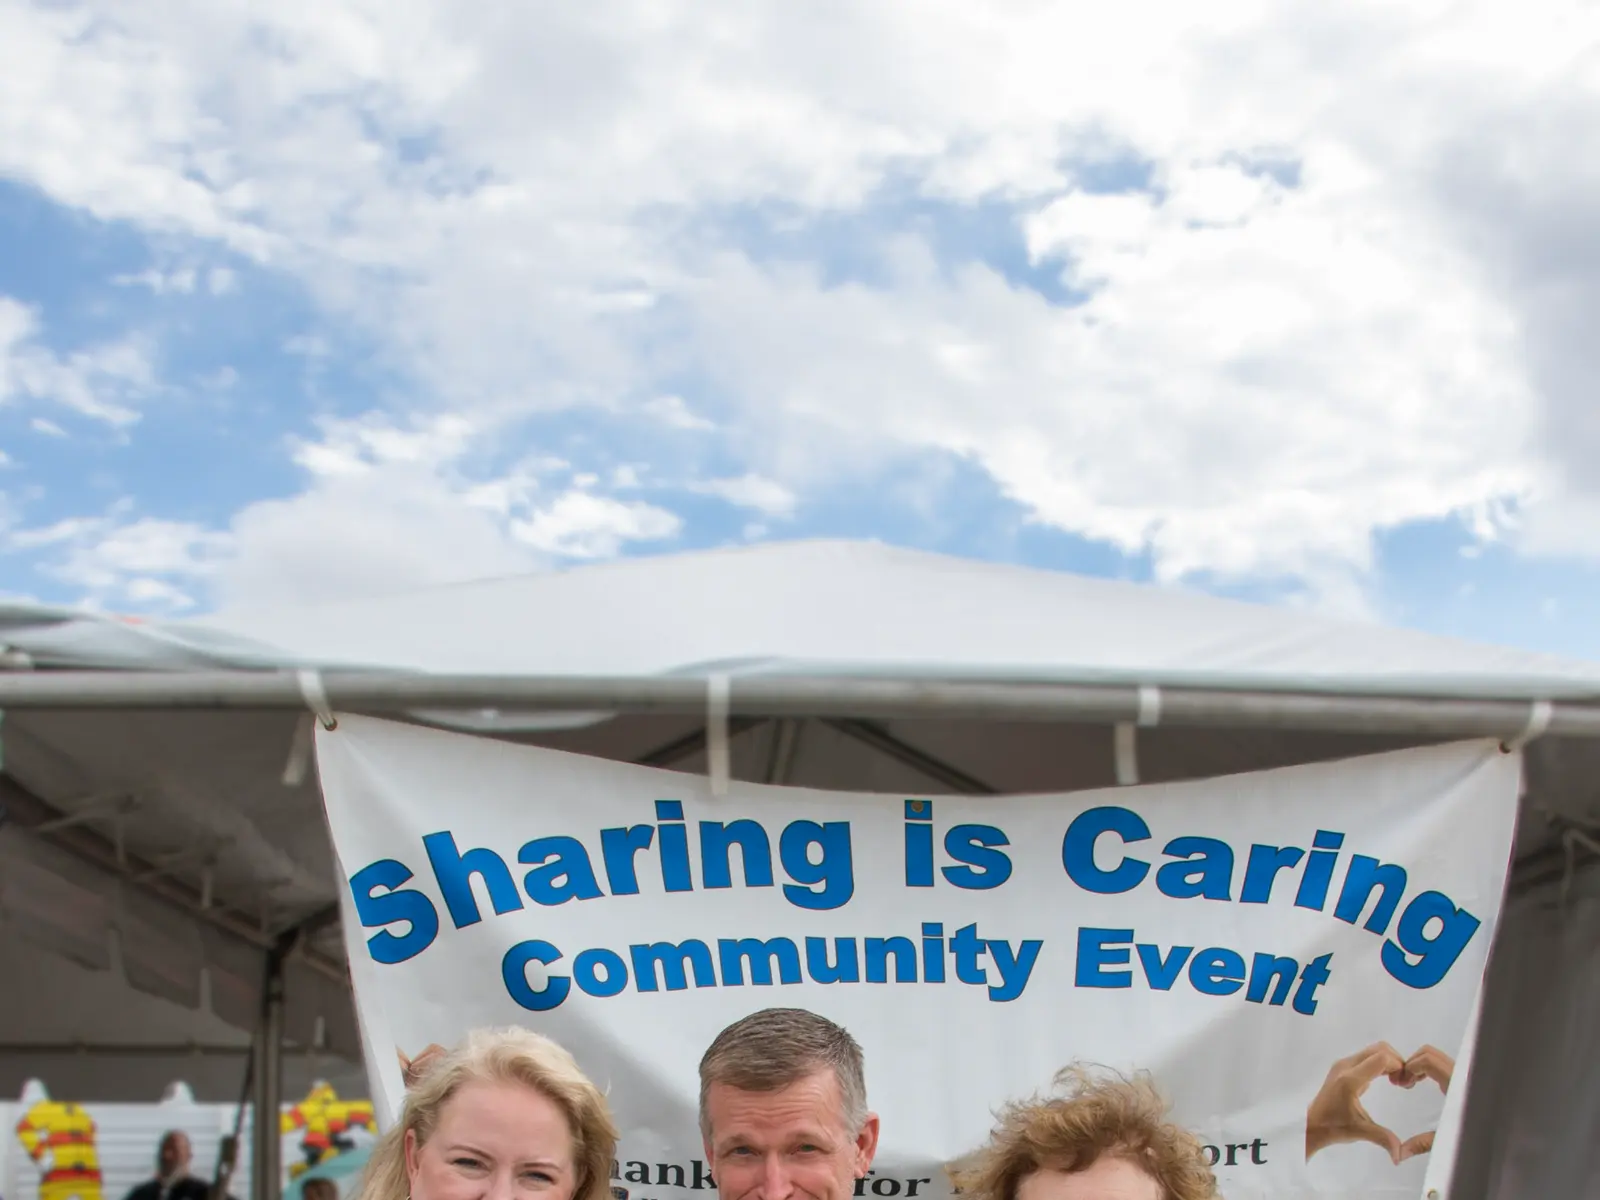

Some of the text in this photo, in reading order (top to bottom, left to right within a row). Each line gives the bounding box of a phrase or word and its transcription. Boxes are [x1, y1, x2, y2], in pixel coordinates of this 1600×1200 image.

[348, 800, 1482, 990] Sharing is Caring
[501, 922, 1334, 1017] Community Event
[853, 1170, 932, 1197] for
[1200, 1138, 1268, 1167] ort
